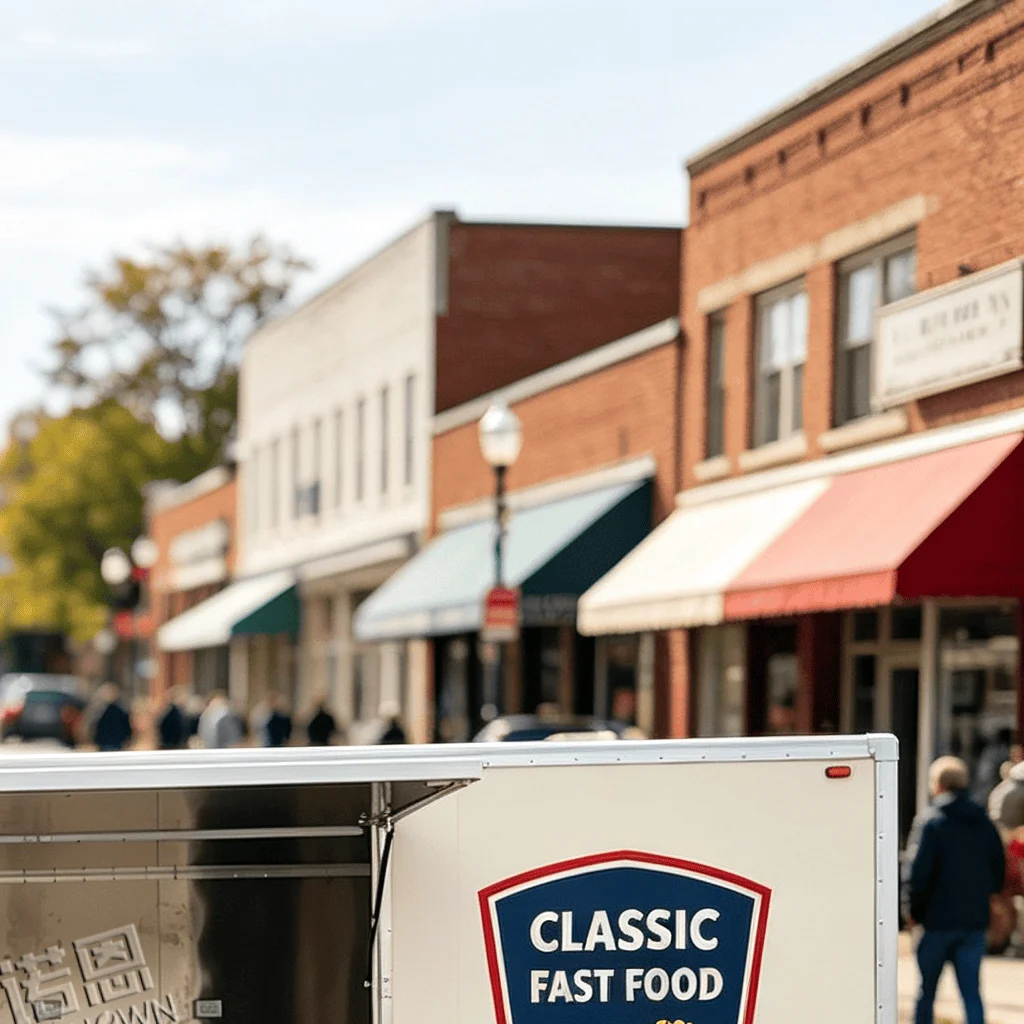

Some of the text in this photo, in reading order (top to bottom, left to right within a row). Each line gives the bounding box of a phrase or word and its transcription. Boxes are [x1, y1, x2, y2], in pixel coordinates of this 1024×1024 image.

[529, 908, 720, 952] CLASSIC
[530, 966, 724, 1003] FAST FOOD
